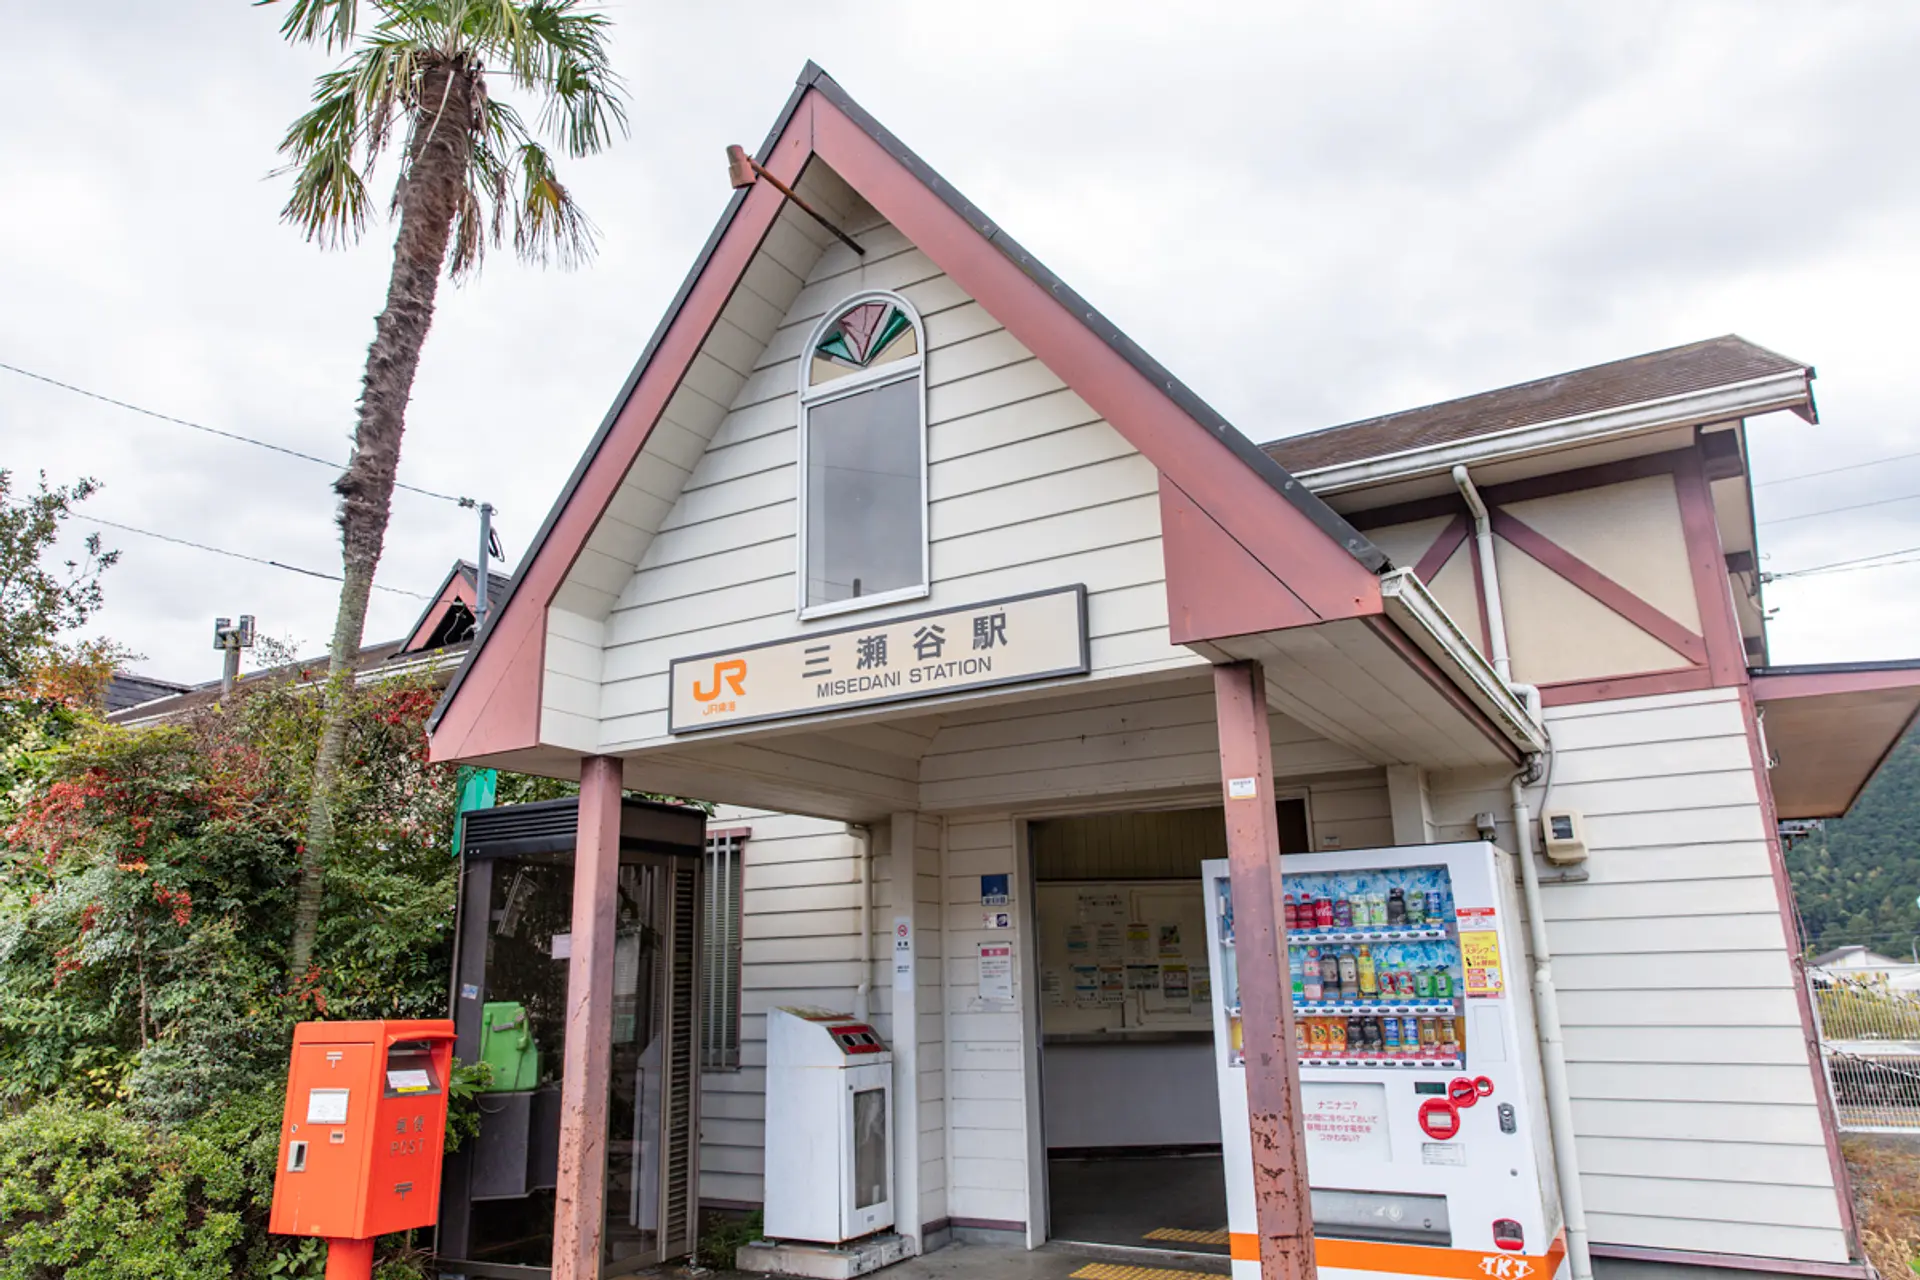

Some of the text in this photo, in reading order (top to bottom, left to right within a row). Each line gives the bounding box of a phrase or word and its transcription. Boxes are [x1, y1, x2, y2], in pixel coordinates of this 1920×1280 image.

[802, 612, 1008, 679] 三瀬谷駅
[693, 659, 747, 702] JR
[817, 656, 992, 698] MISEDANI STATION
[702, 701, 736, 716] JR東海
[390, 1138, 424, 1156] POST
